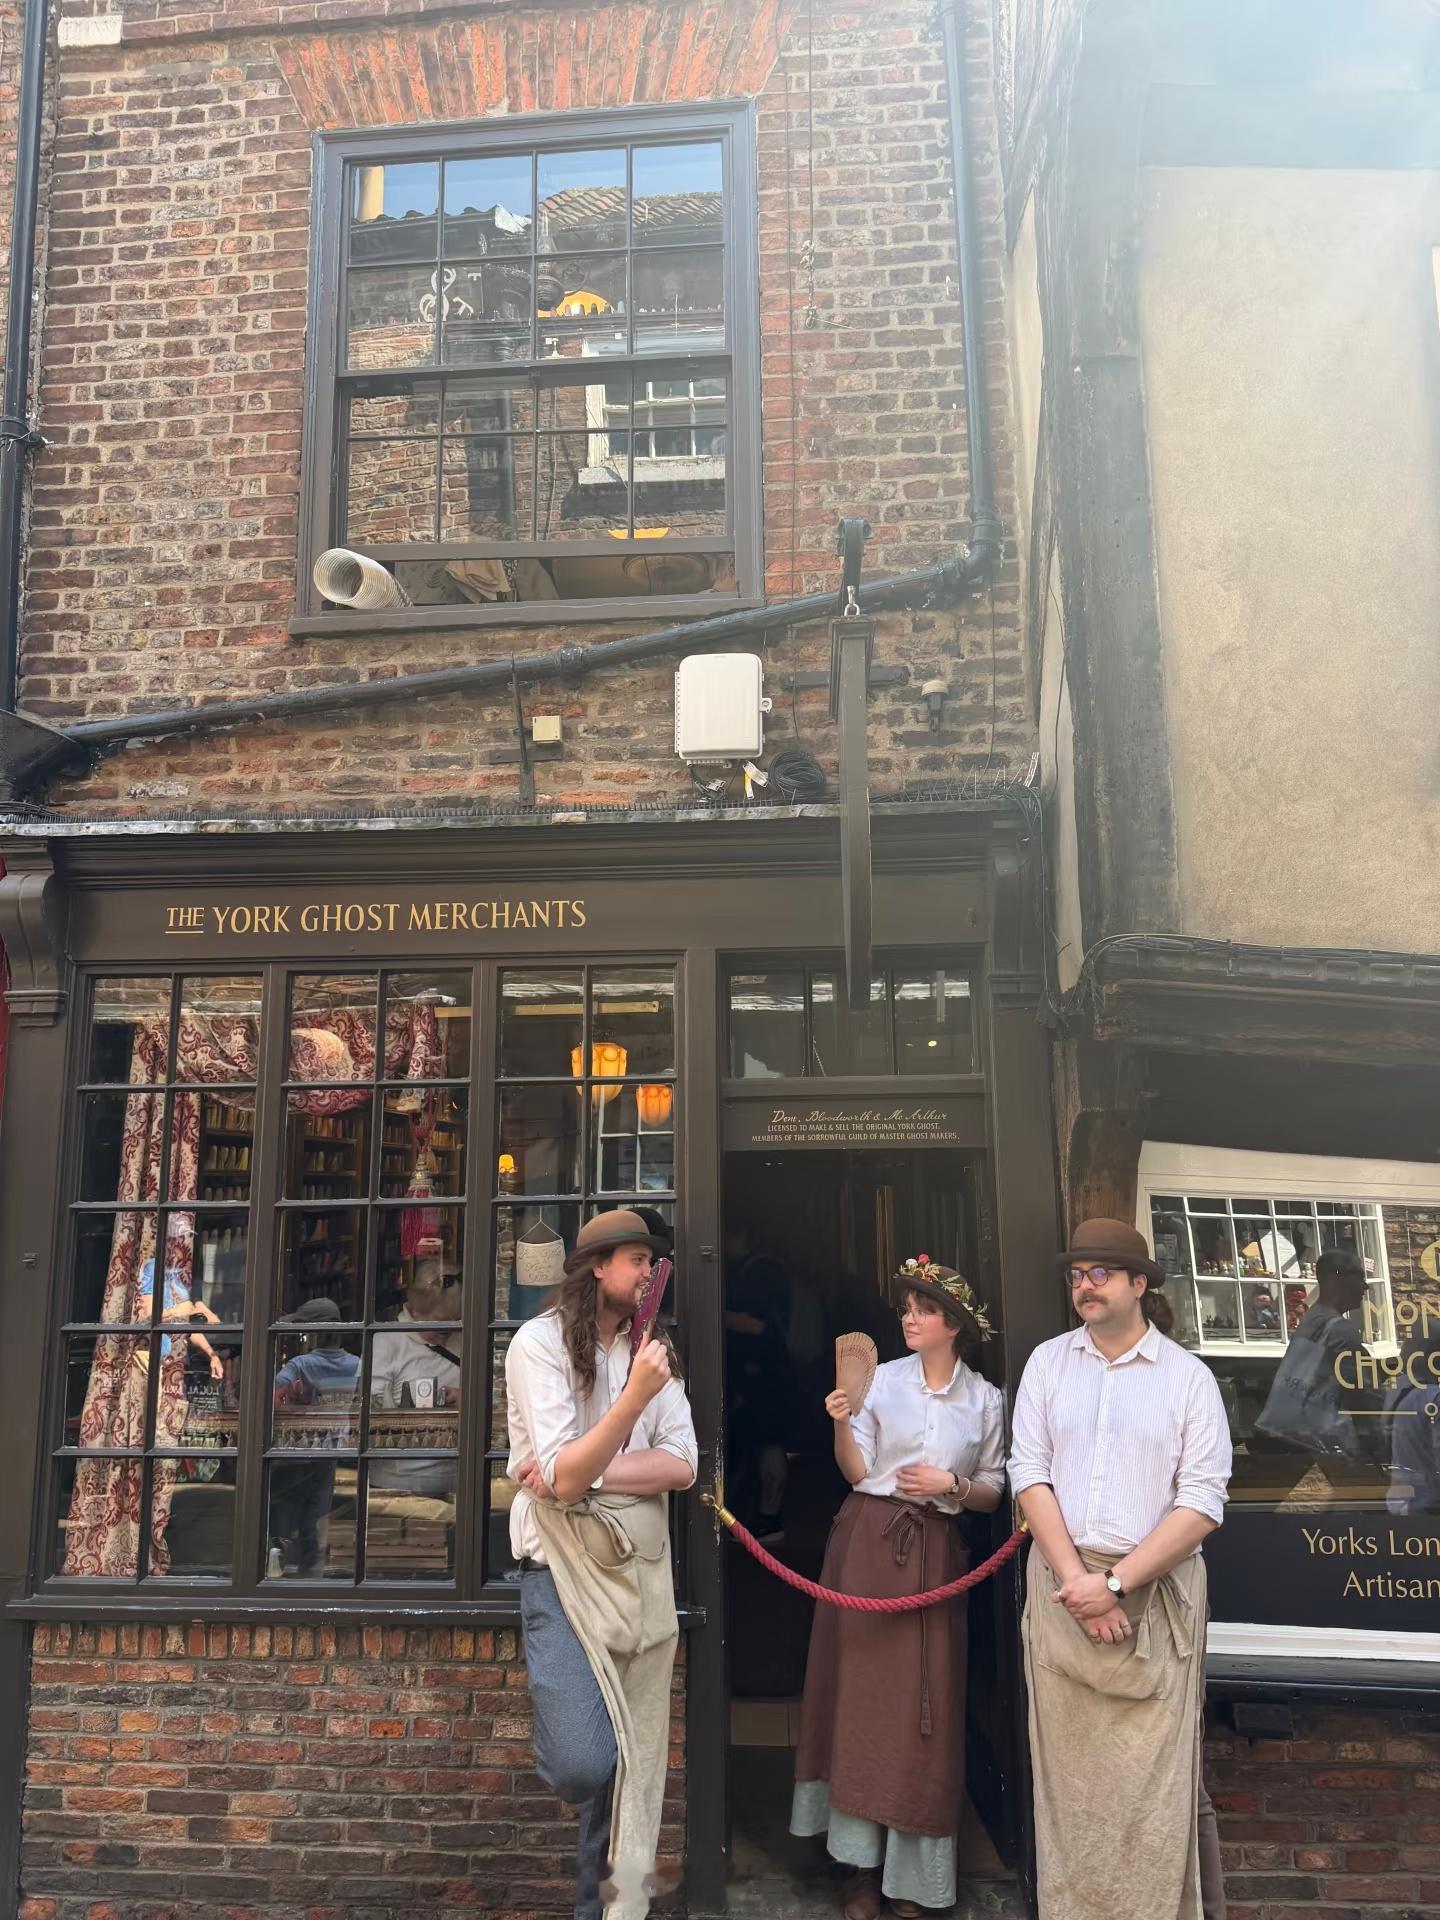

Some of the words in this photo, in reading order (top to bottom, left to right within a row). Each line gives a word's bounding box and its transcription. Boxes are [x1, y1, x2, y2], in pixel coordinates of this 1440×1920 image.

[165, 907, 204, 931] THE
[211, 906, 291, 934] YORK
[300, 903, 400, 931] GHOST
[408, 900, 587, 930] MERCHANTS
[805, 1109, 872, 1122] Bloodworth
[873, 1112, 881, 1121] &
[752, 1134, 783, 1142] MEMBERS
[794, 1133, 806, 1141] THE
[807, 1133, 847, 1141] SORROWFUL
[848, 1133, 868, 1141] GUILD
[879, 1132, 905, 1140] MASTER
[906, 1132, 928, 1140] GHOST
[767, 1124, 798, 1133] LICENSED
[799, 1124, 808, 1132] TO
[809, 1123, 828, 1132] MAKE
[828, 1124, 834, 1132] &
[835, 1123, 850, 1132] SELL
[852, 1123, 864, 1131] THE
[865, 1123, 897, 1131] ORIGINAL
[897, 1122, 916, 1131] YORK
[1301, 1527, 1378, 1556] Yorks
[1389, 1529, 1440, 1557] Lon
[1343, 1570, 1440, 1599] Artisan
